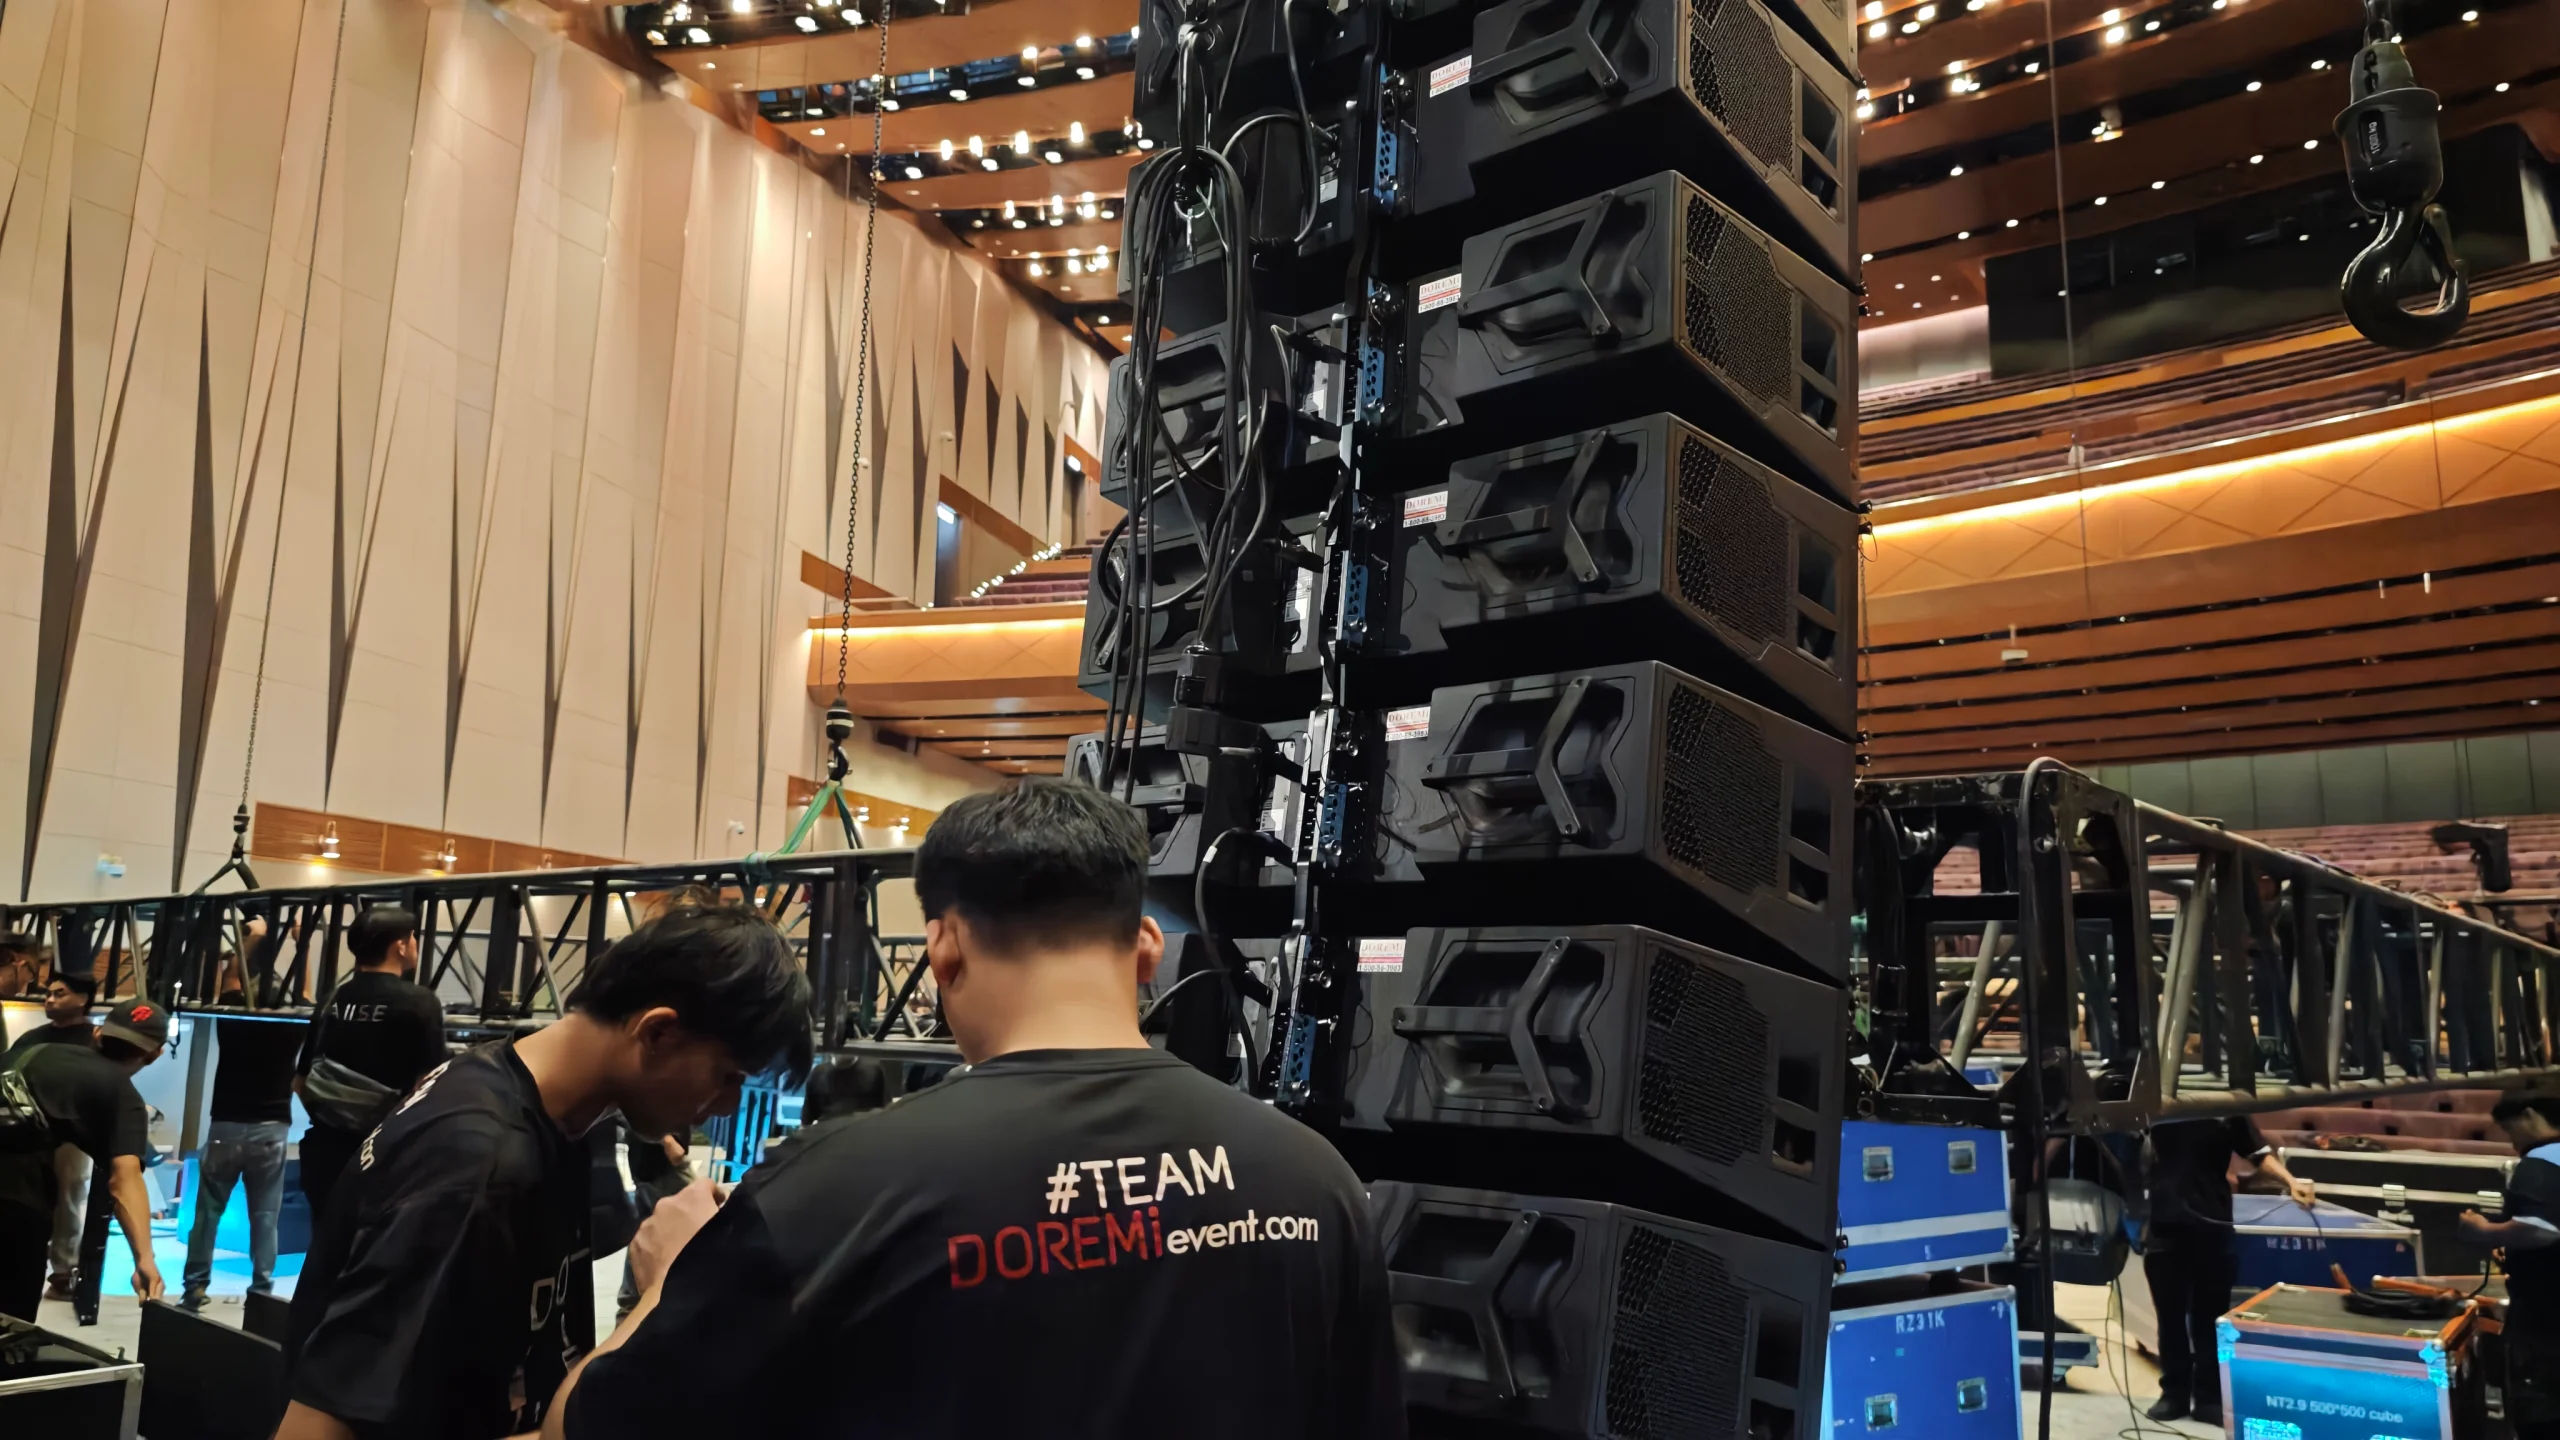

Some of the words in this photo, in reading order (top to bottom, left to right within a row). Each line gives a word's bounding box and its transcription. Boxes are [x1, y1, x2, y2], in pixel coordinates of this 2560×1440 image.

[1045, 1145, 1235, 1214] #TEAM
[1895, 1310, 1945, 1334] RZ31K
[2266, 1395, 2307, 1412] NT2.9
[2369, 1409, 2404, 1424] cube
